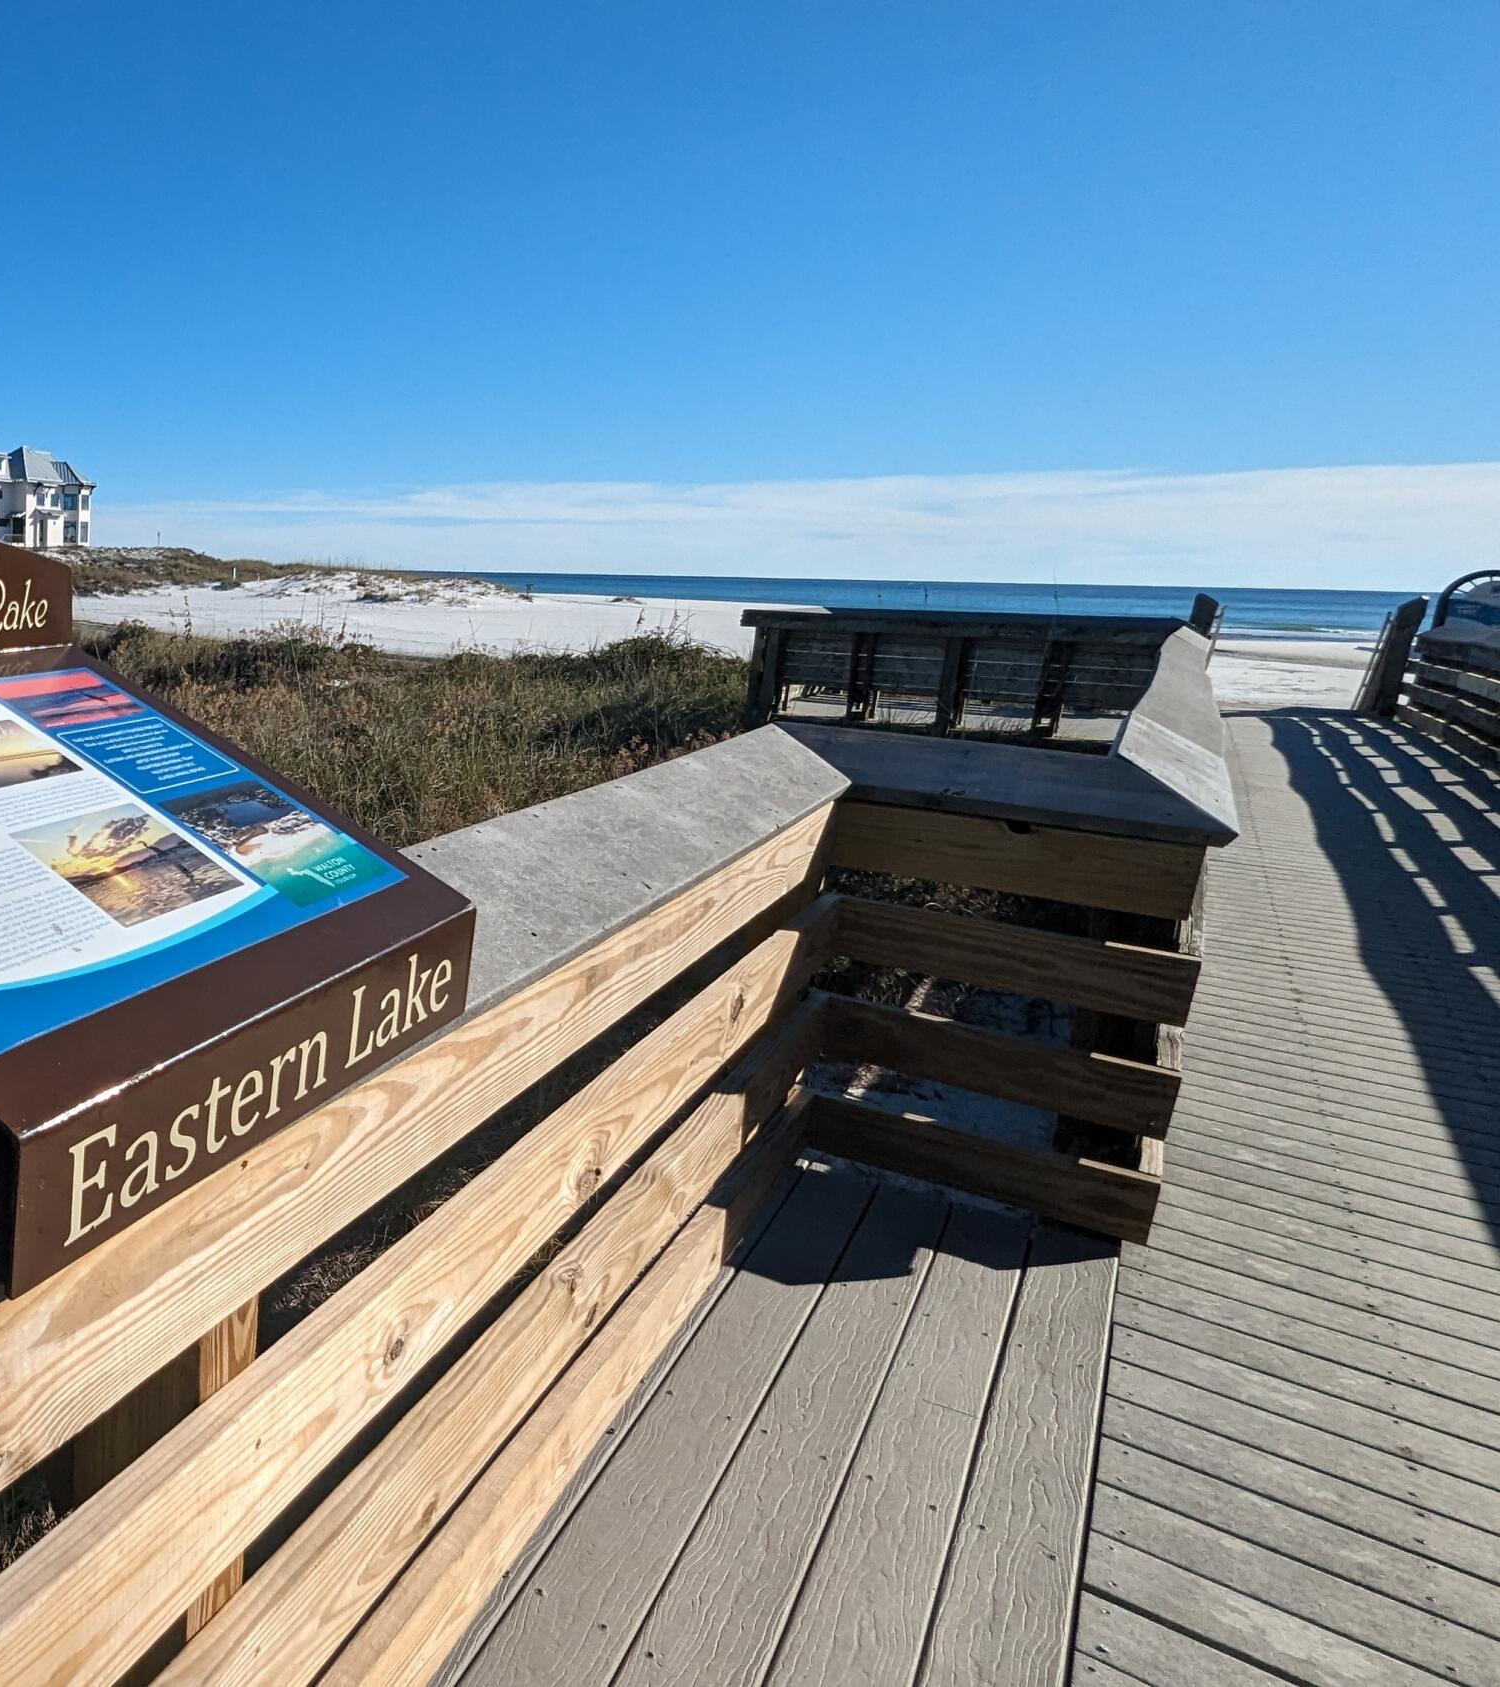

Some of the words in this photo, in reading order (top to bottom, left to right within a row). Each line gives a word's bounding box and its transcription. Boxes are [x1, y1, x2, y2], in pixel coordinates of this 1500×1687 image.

[311, 857, 347, 872] WALTON
[323, 863, 357, 880] COUNTY
[63, 1030, 328, 1248] Eastern
[344, 953, 453, 1070] Lake
